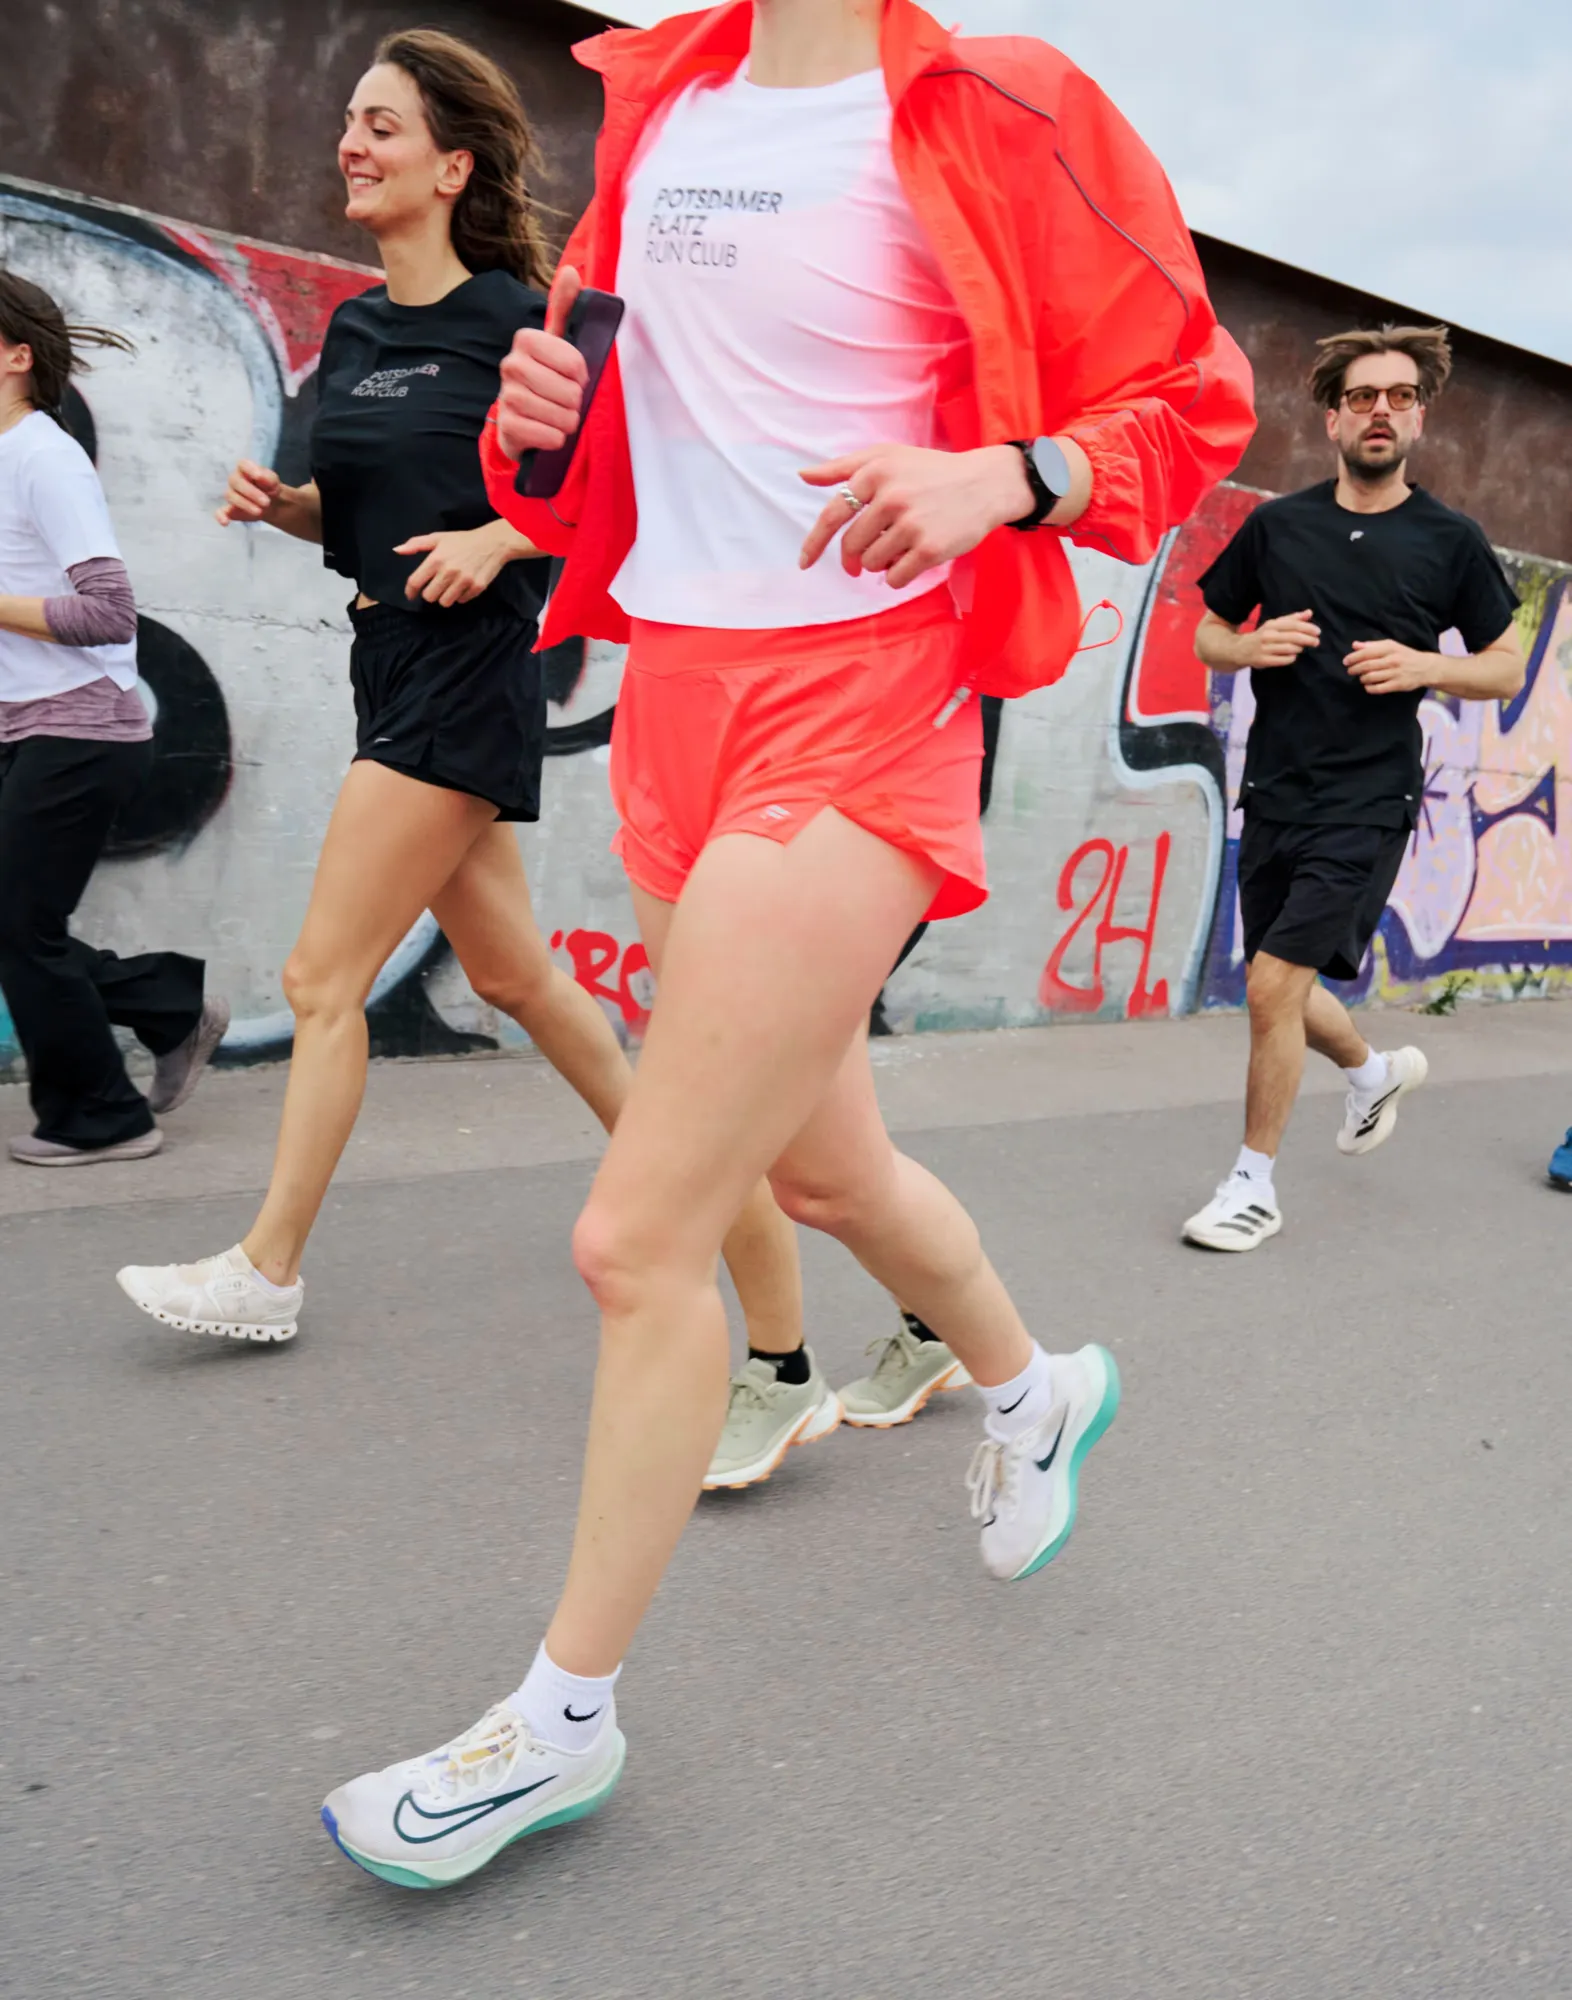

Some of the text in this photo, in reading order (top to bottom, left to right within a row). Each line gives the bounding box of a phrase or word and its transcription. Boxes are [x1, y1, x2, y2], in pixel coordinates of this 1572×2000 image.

[655, 187, 783, 214] POTSDAMER
[649, 214, 708, 236] PLATZ
[645, 241, 738, 268] RUN CLUB
[351, 386, 409, 397] RUN CLUB
